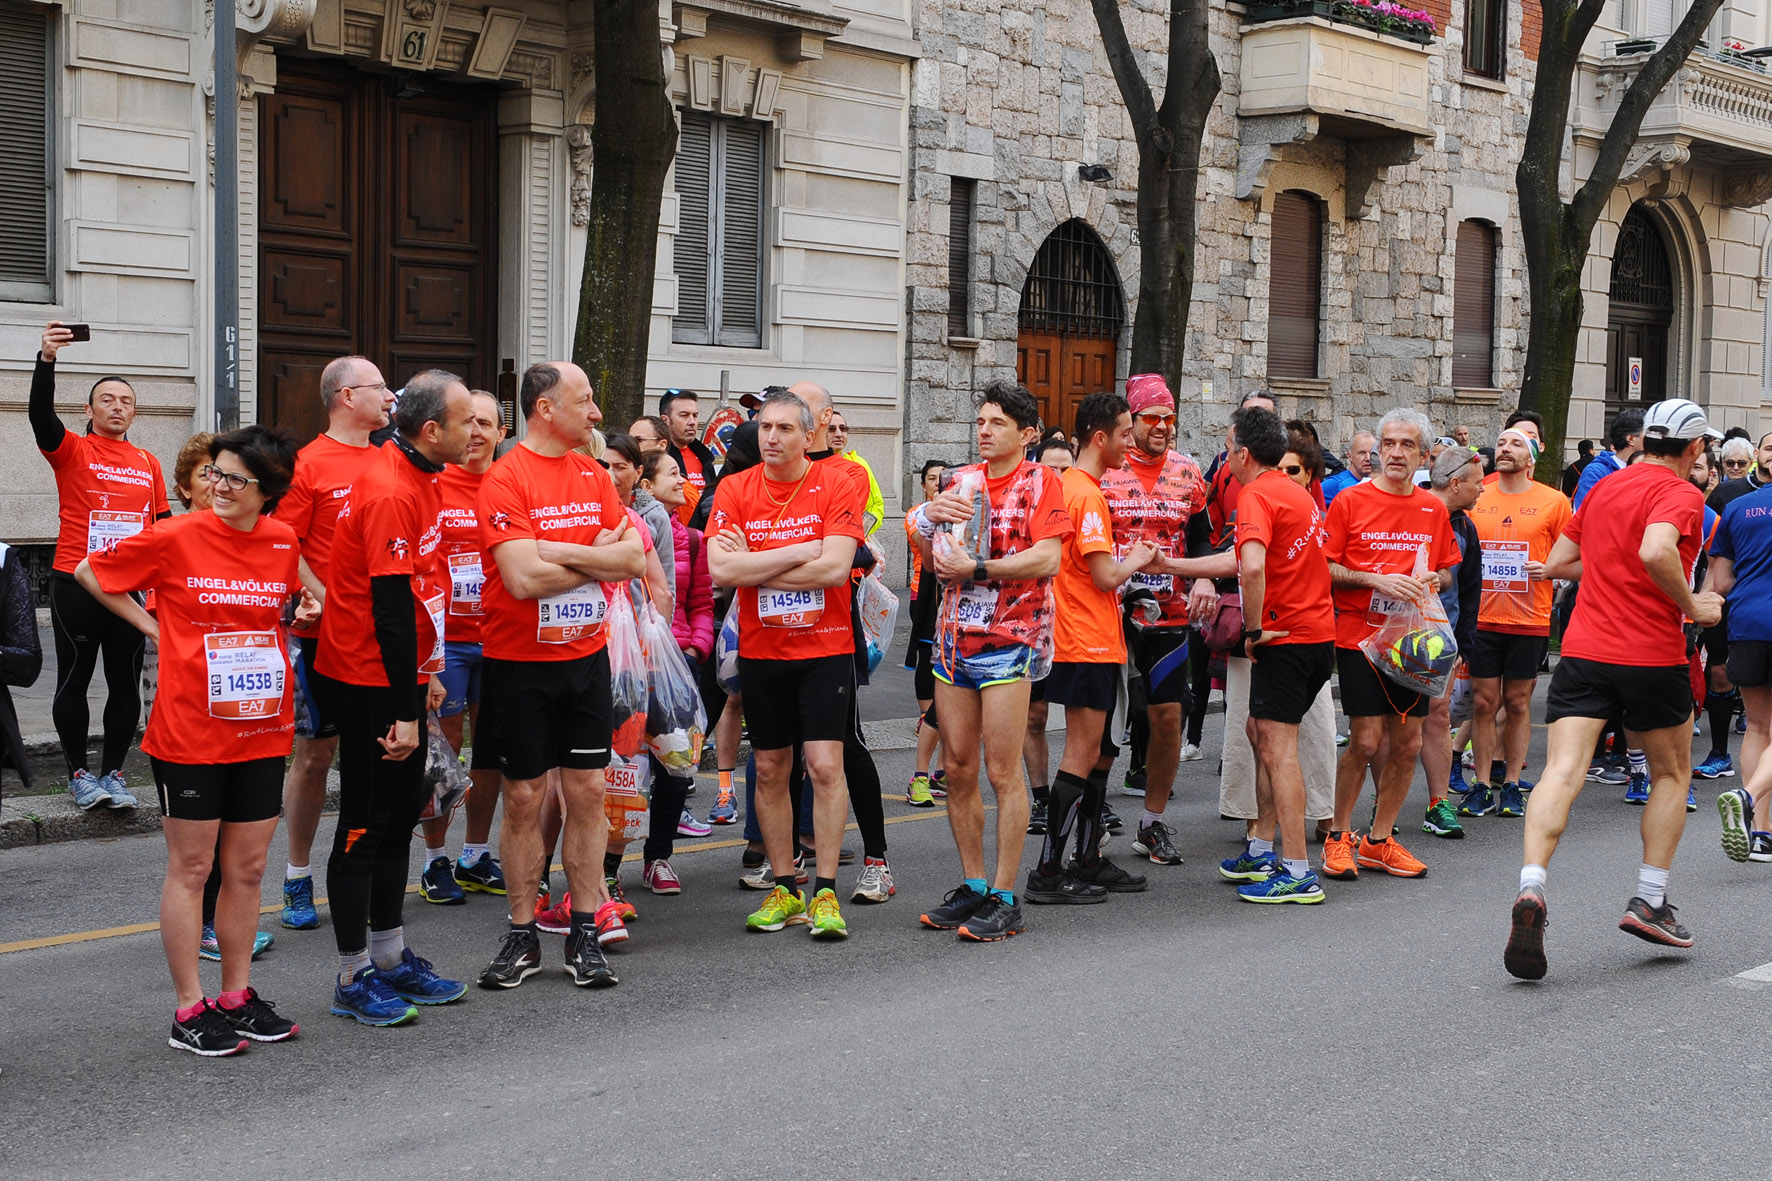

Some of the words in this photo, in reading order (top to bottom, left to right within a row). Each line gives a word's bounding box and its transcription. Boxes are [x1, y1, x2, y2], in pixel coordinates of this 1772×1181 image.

[403, 31, 425, 60] 61
[96, 472, 151, 488] COMMERCIAL
[1118, 509, 1181, 518] COMMERCIAL
[1520, 506, 1537, 514] EA7
[1745, 507, 1766, 518] RUN
[445, 519, 478, 528] COMM
[1487, 565, 1517, 576] 1485B
[1493, 580, 1511, 588] EA7
[771, 591, 812, 608] 1454B
[555, 602, 593, 619] 1457B
[782, 612, 805, 624] EA7
[562, 625, 584, 638] EA7
[218, 636, 239, 646] EA7
[227, 672, 272, 692] 1453B
[238, 699, 266, 713] EA7
